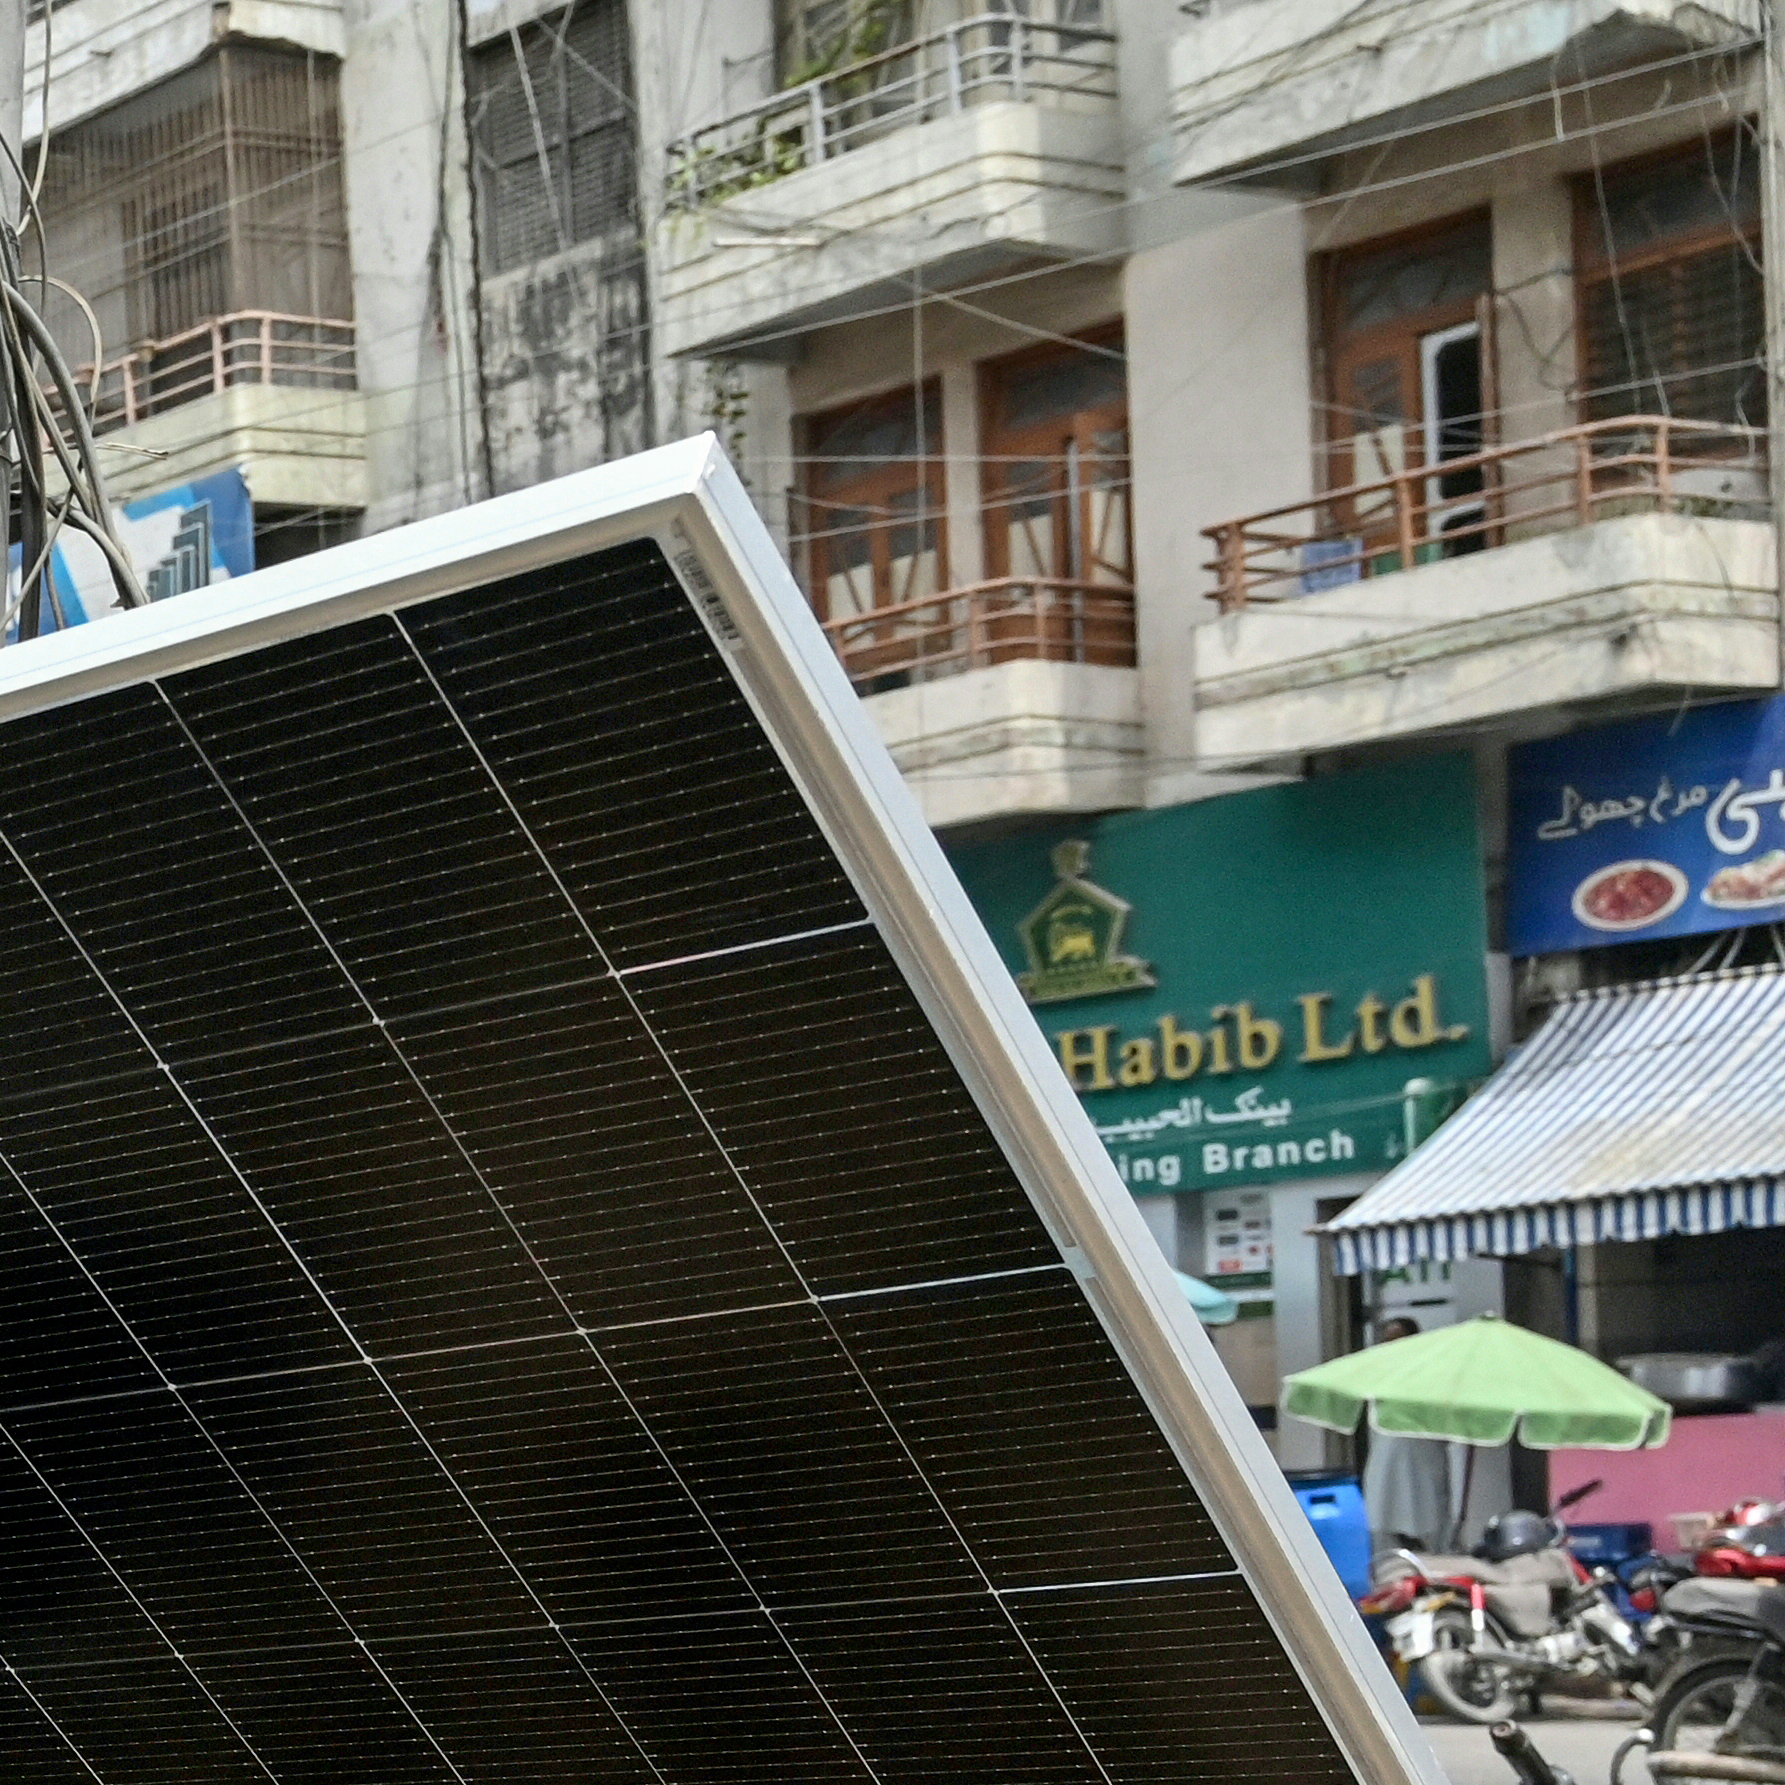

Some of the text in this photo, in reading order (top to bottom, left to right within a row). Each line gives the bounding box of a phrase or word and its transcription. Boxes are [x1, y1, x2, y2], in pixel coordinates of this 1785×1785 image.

[1053, 973, 1470, 1092] Habib Ltd.
[1202, 1129, 1356, 1175] Branch
